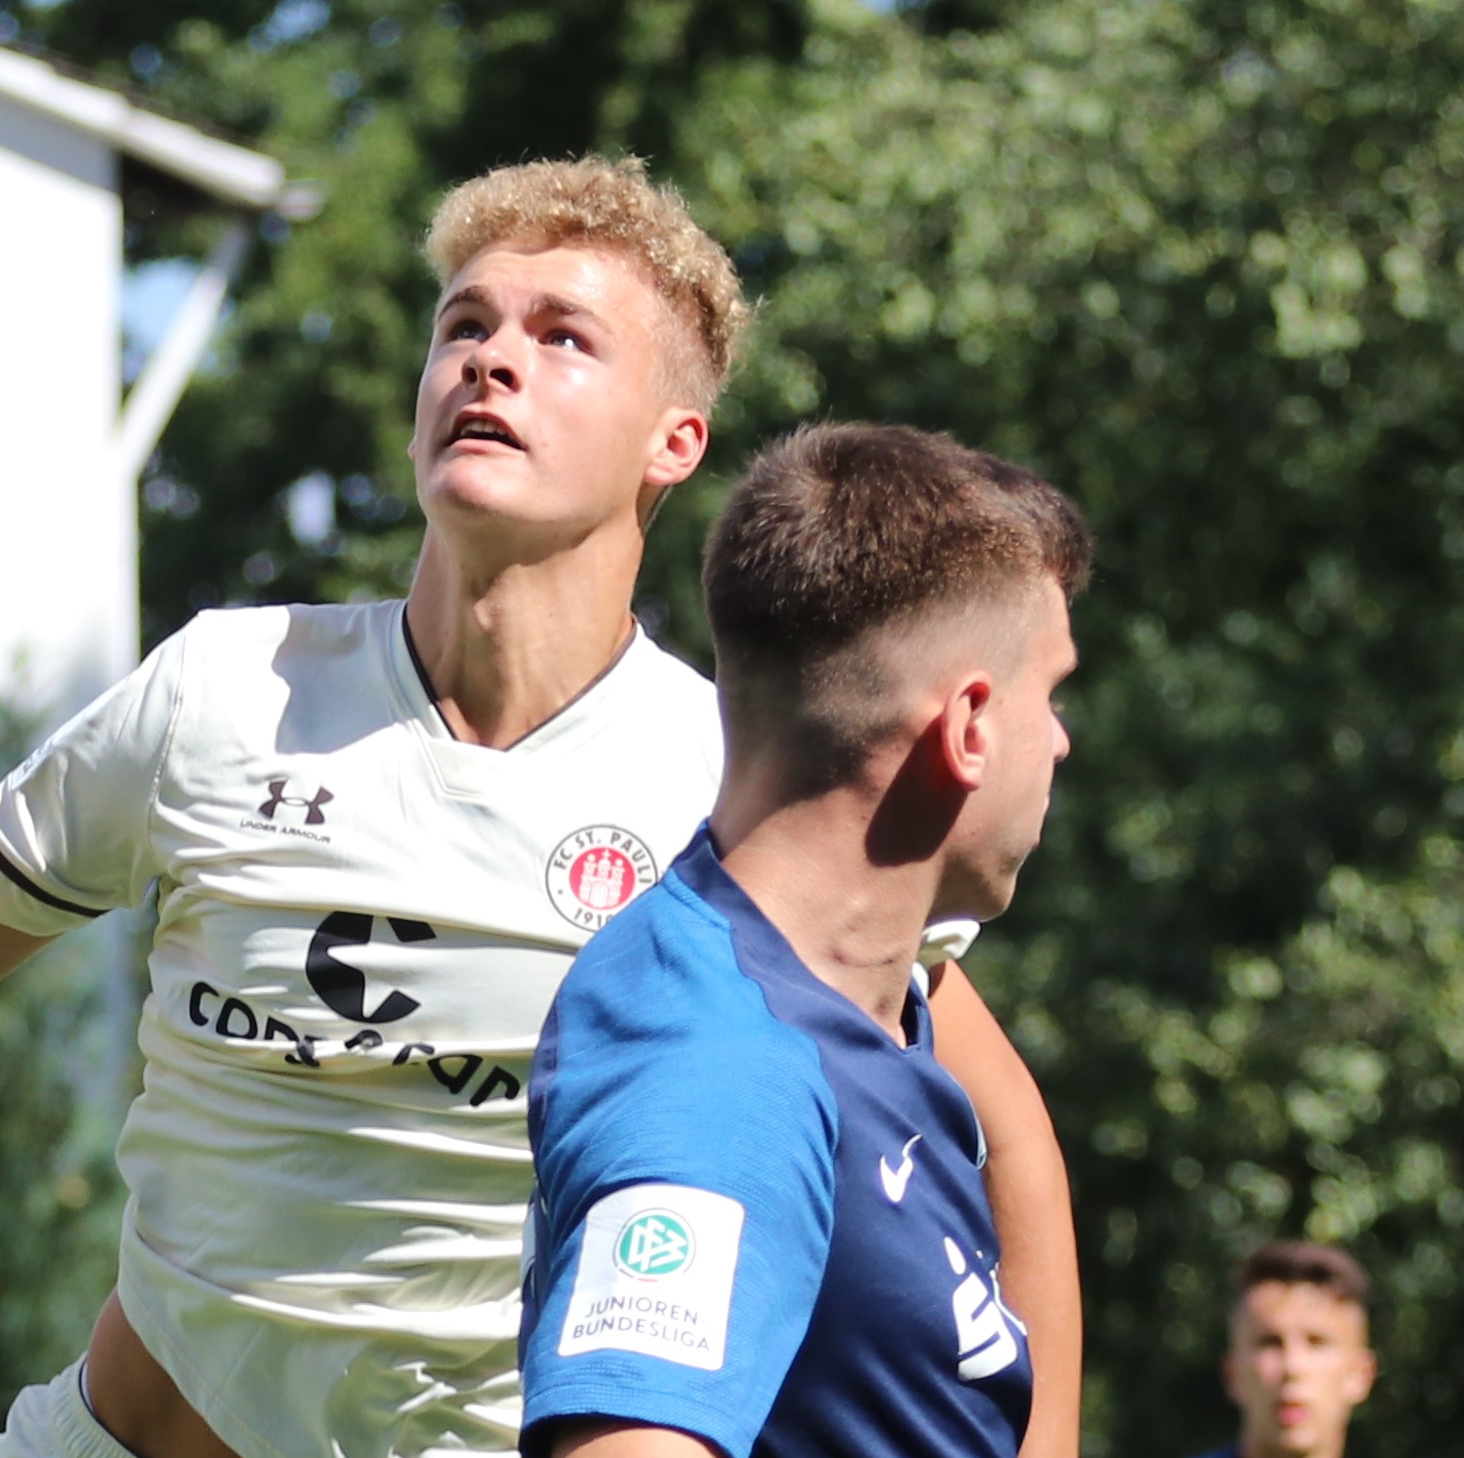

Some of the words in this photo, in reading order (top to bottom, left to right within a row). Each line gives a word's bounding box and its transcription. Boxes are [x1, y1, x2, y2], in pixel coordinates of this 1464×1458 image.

[239, 818, 278, 834] UNDER
[279, 825, 332, 845] ARMOUR
[553, 847, 574, 871] FC
[574, 830, 602, 849] ST.
[610, 831, 653, 885] PAULI
[571, 1316, 710, 1351] BUNDESLIGA
